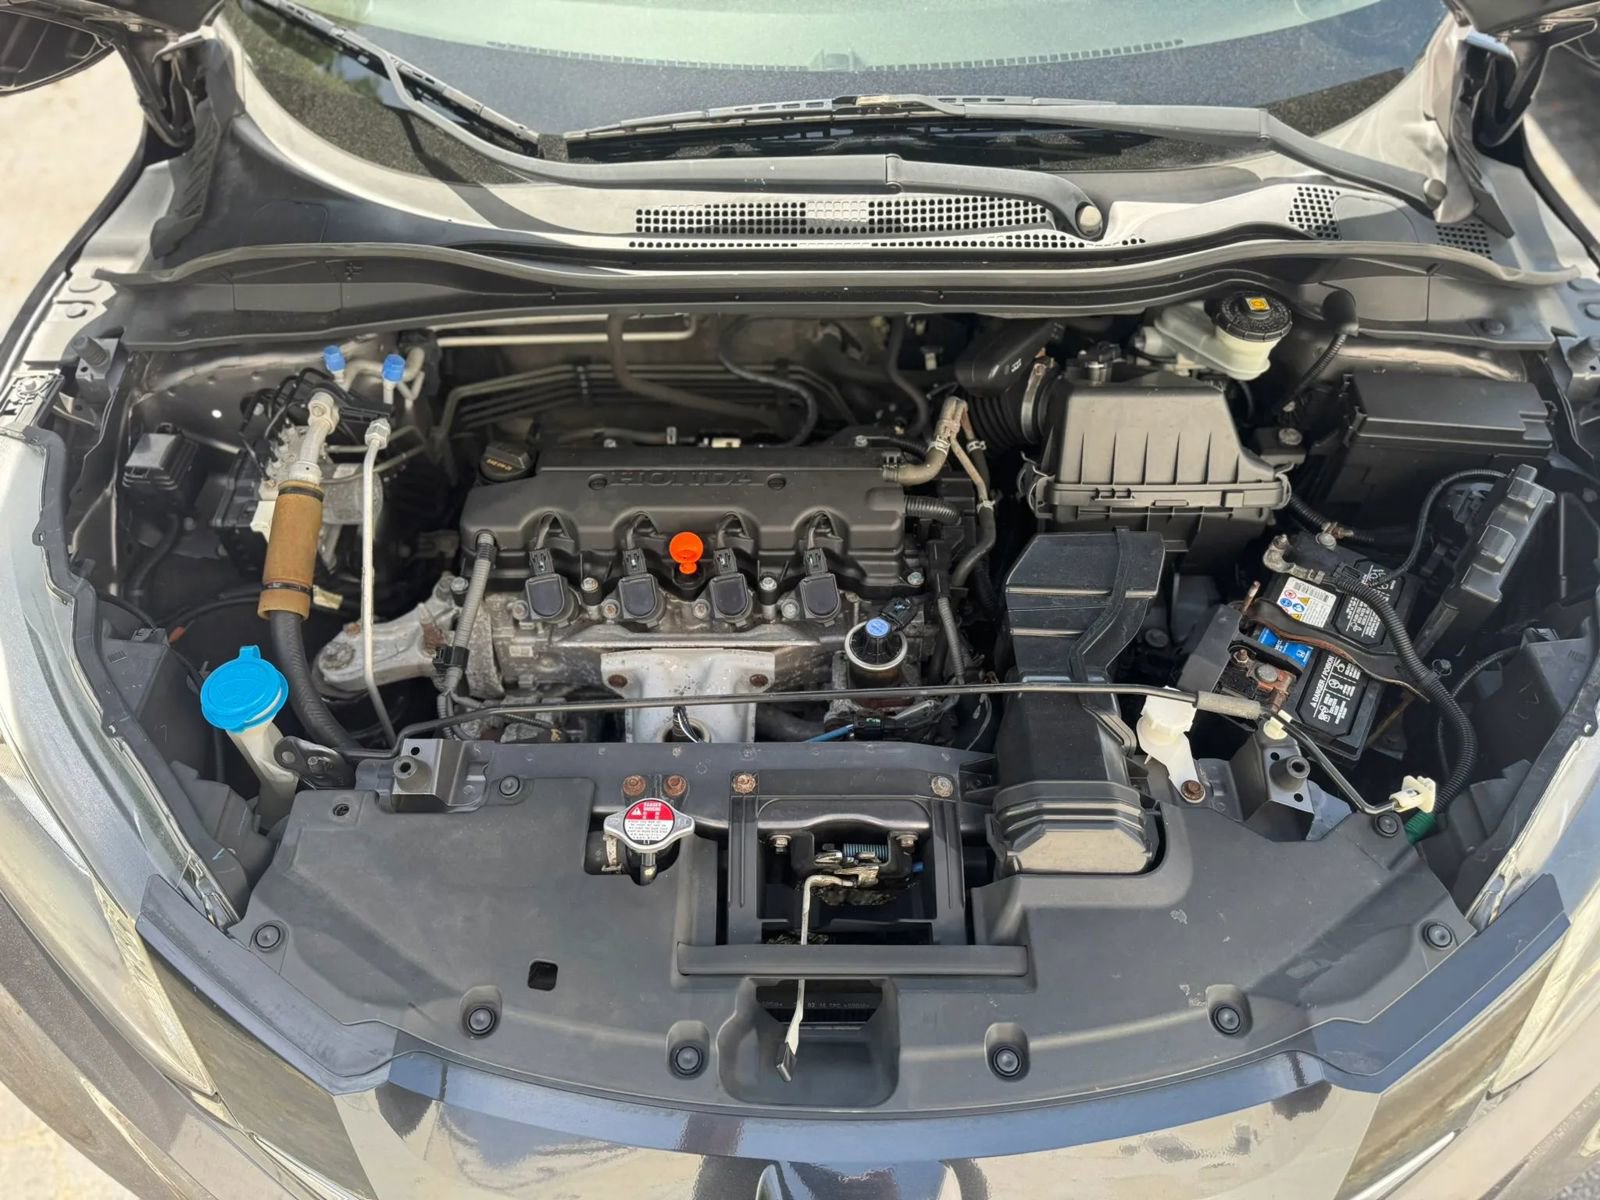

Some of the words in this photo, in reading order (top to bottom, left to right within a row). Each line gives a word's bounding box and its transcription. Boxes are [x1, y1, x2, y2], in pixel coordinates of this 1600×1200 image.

[610, 471, 765, 487] HONDA
[1311, 679, 1325, 702] DANGER
[1322, 655, 1335, 676] POISON
